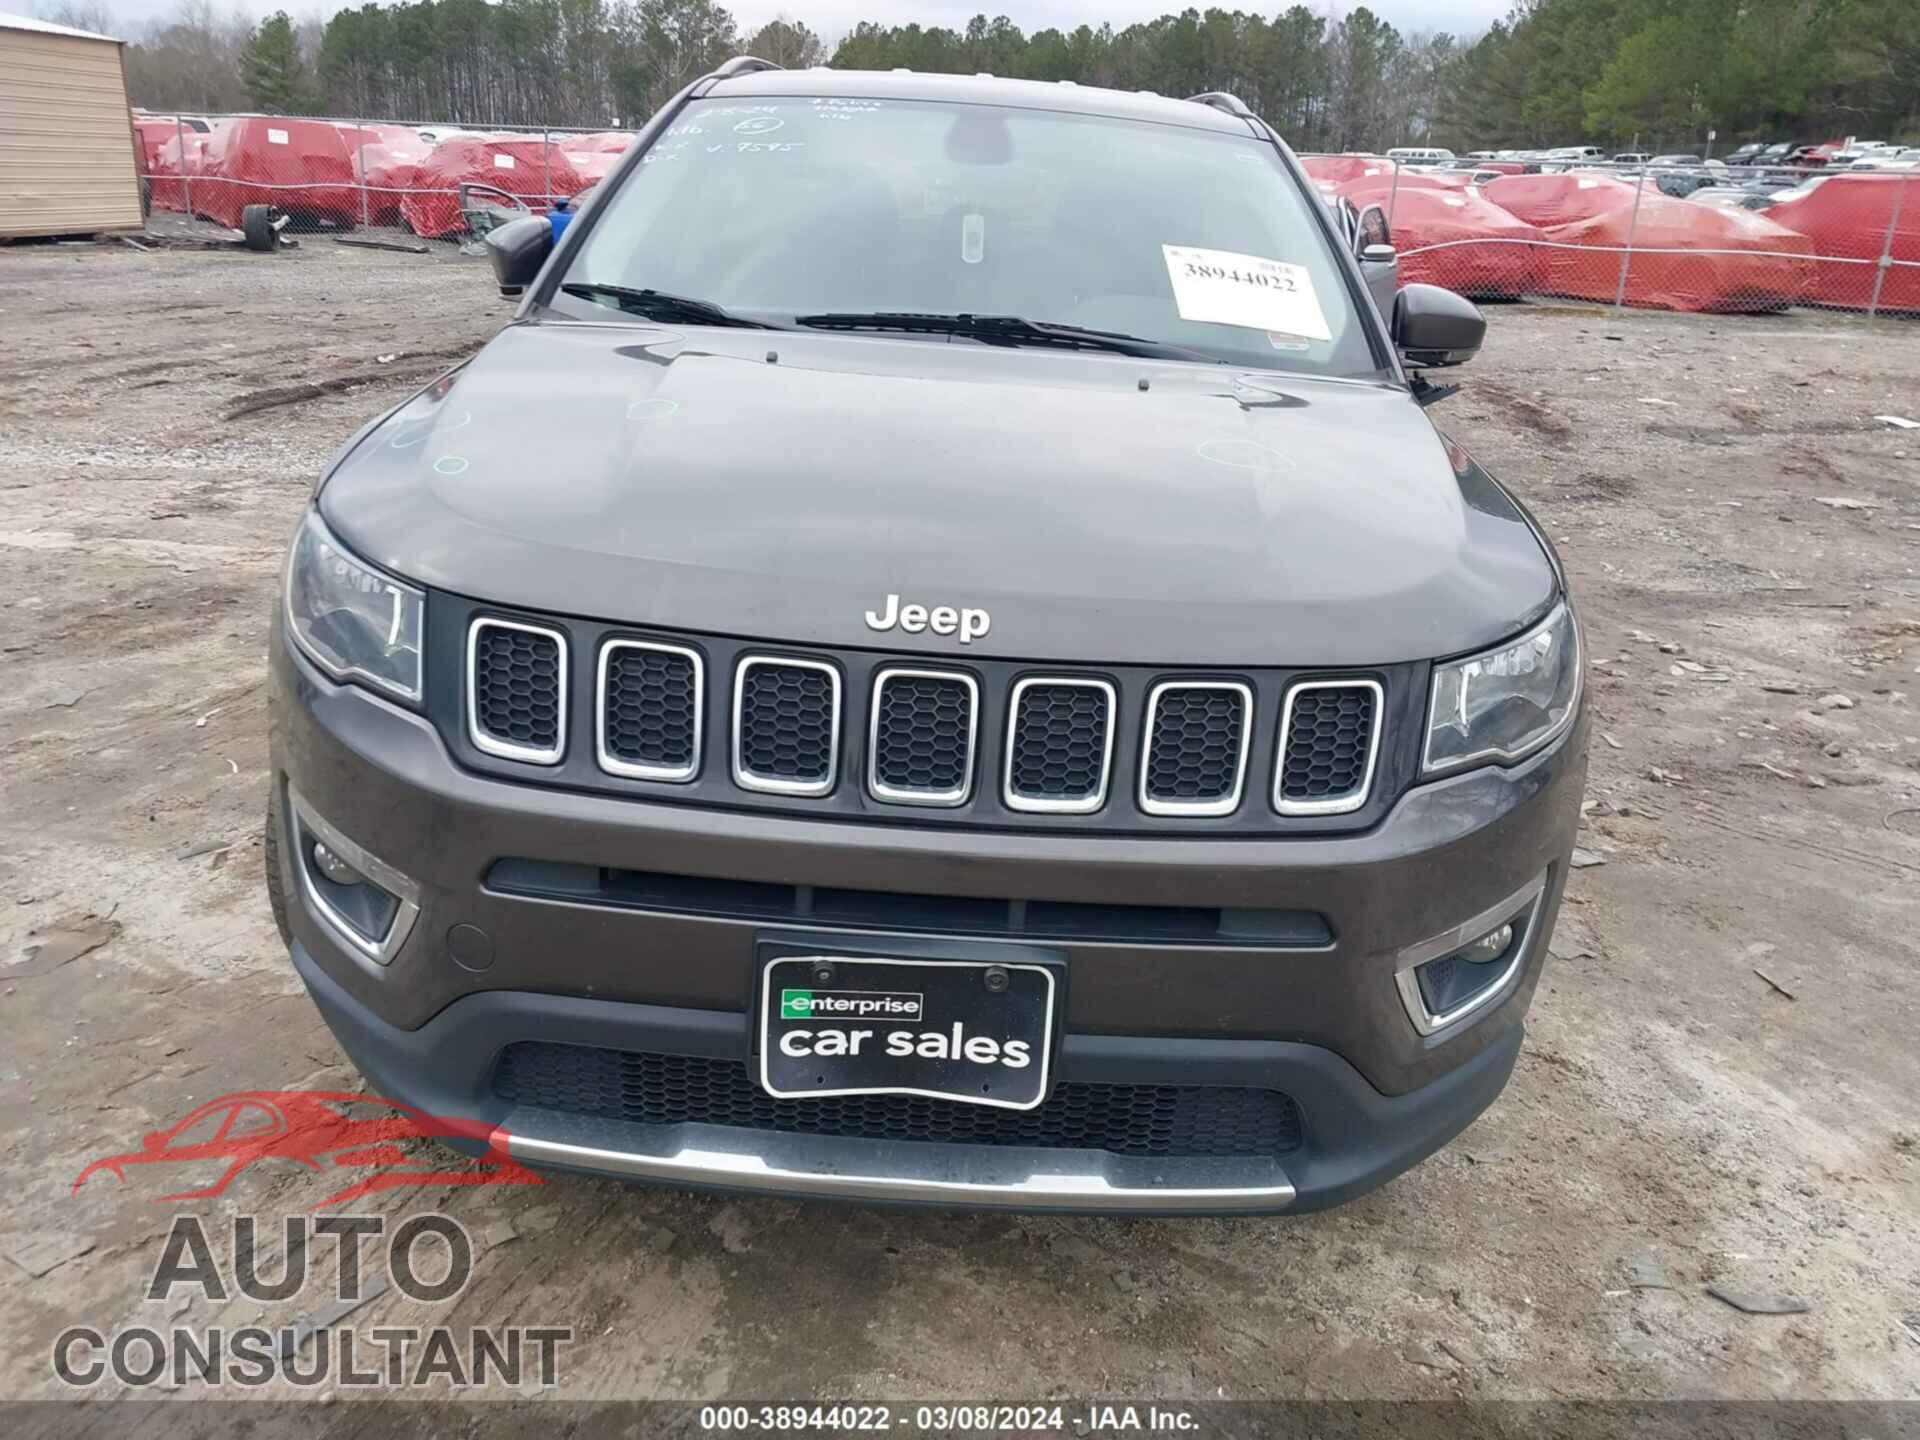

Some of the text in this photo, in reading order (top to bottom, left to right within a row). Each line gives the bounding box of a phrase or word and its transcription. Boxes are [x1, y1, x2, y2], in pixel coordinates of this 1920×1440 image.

[1184, 263, 1297, 293] 38944022
[864, 594, 991, 644] Jeep
[784, 995, 920, 1015] enterprise
[779, 1021, 1031, 1068] car sales
